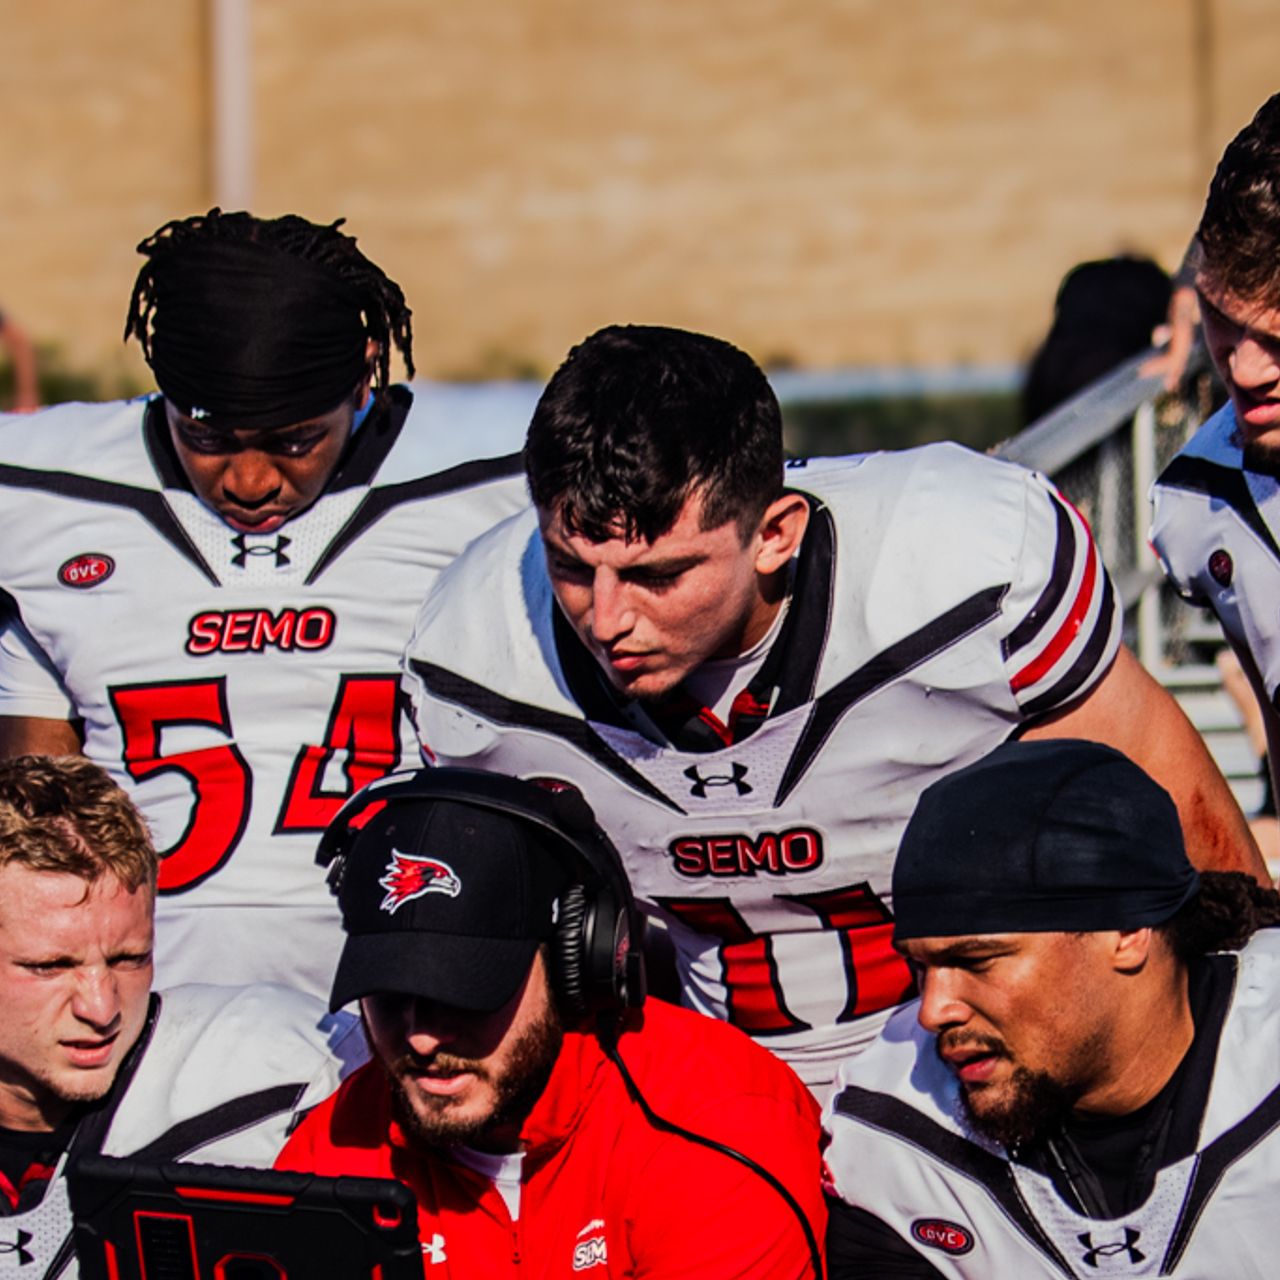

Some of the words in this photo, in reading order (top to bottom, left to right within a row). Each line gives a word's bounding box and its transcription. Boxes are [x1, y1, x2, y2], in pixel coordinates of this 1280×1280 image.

[185, 606, 337, 657] SEMO
[107, 673, 404, 896] 54
[669, 826, 823, 877] SEMO
